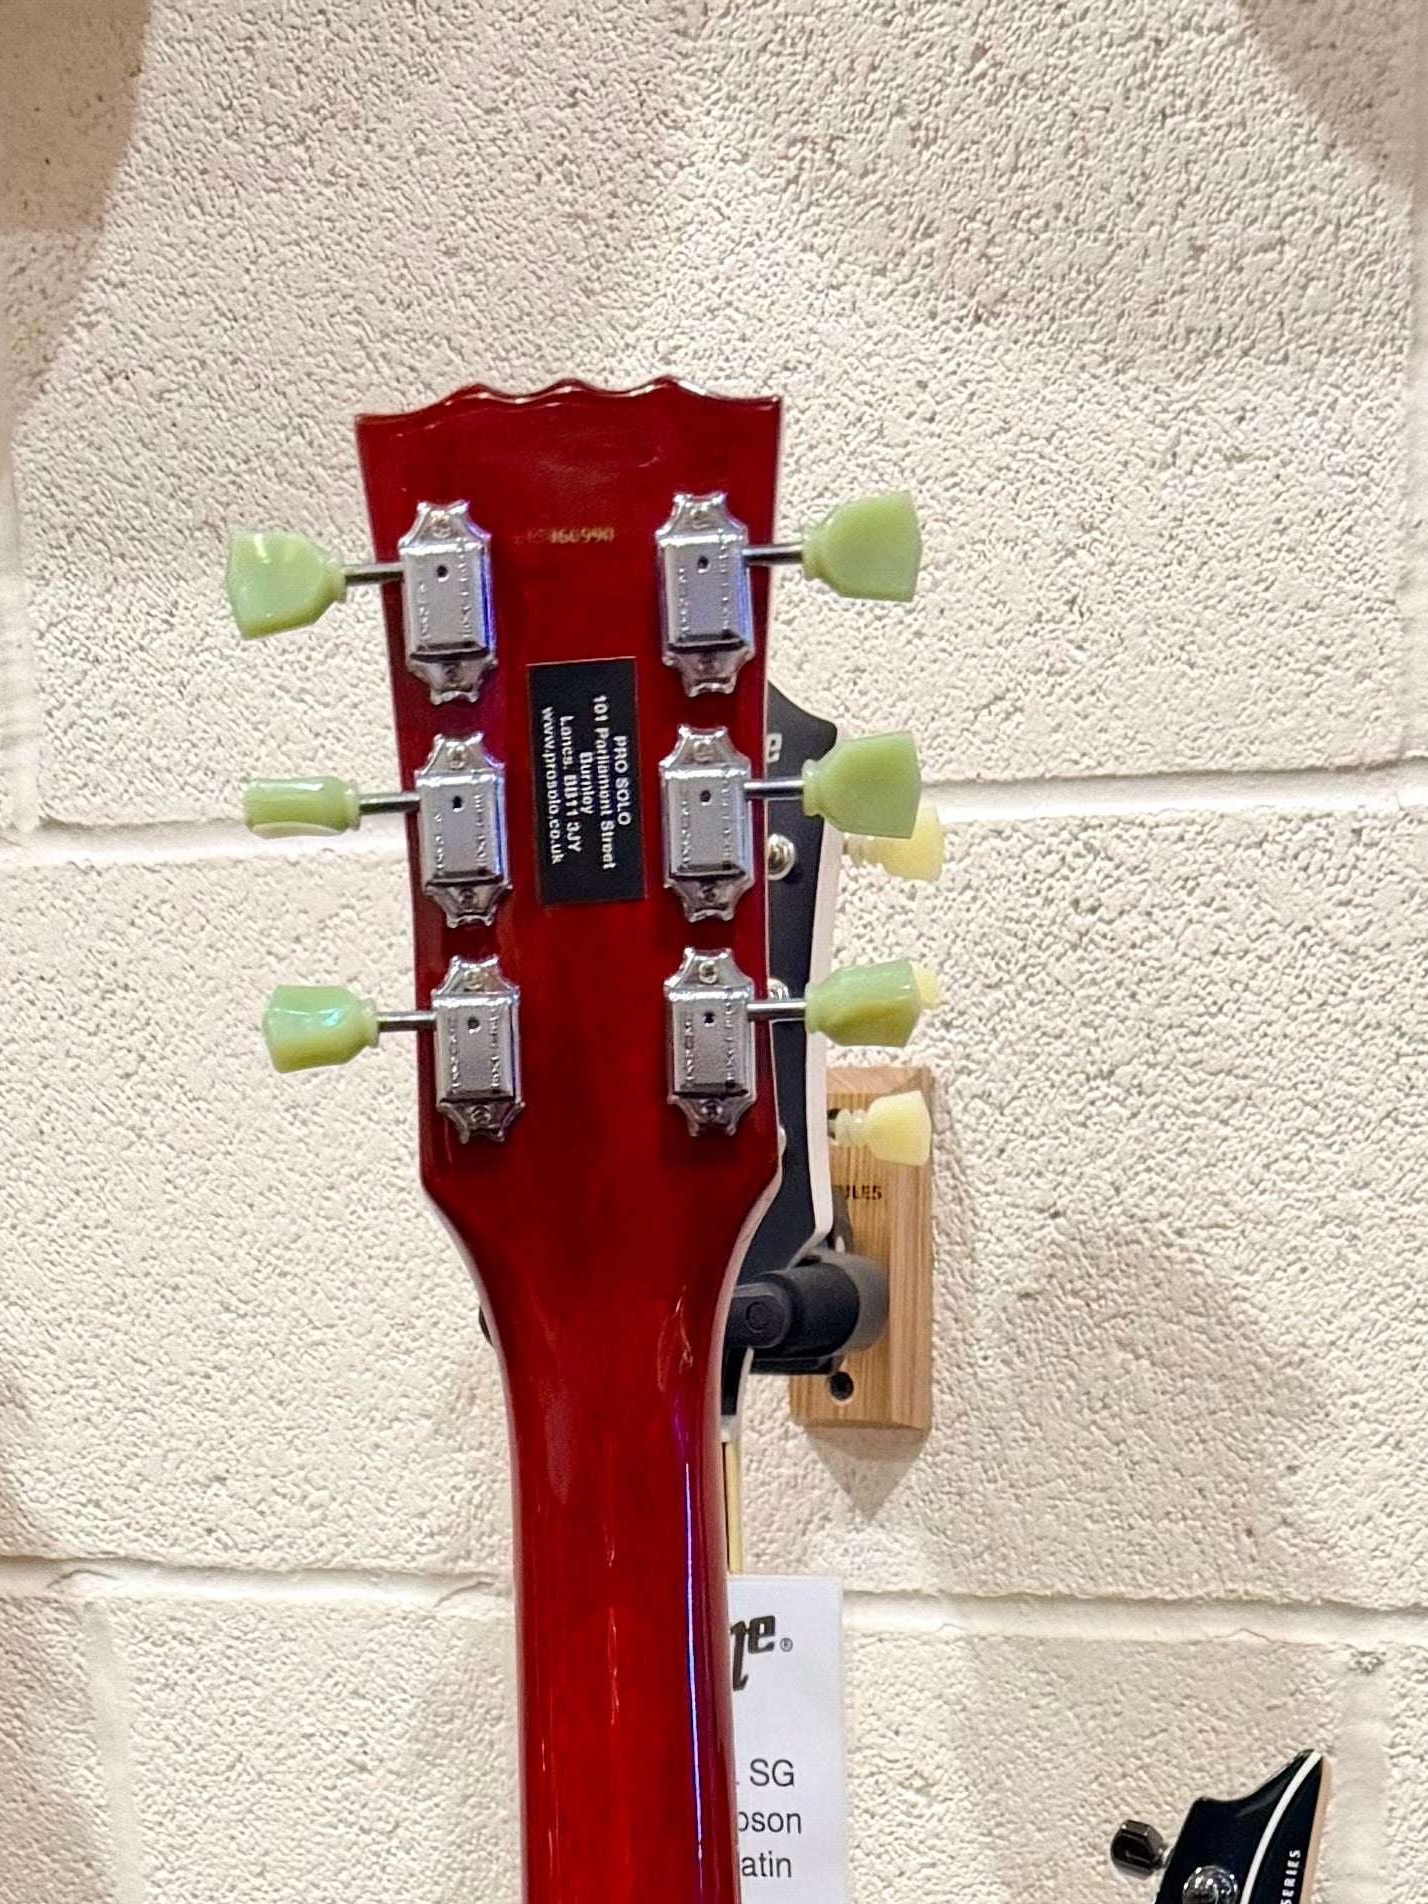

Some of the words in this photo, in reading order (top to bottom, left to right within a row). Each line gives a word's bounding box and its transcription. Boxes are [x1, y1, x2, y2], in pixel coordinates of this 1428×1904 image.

[593, 695, 609, 722] 101
[613, 735, 628, 773] PRO
[616, 777, 632, 825] SOLO
[565, 821, 582, 853] 3JY
[750, 1758, 795, 1788] SG
[741, 1850, 792, 1879] atin
